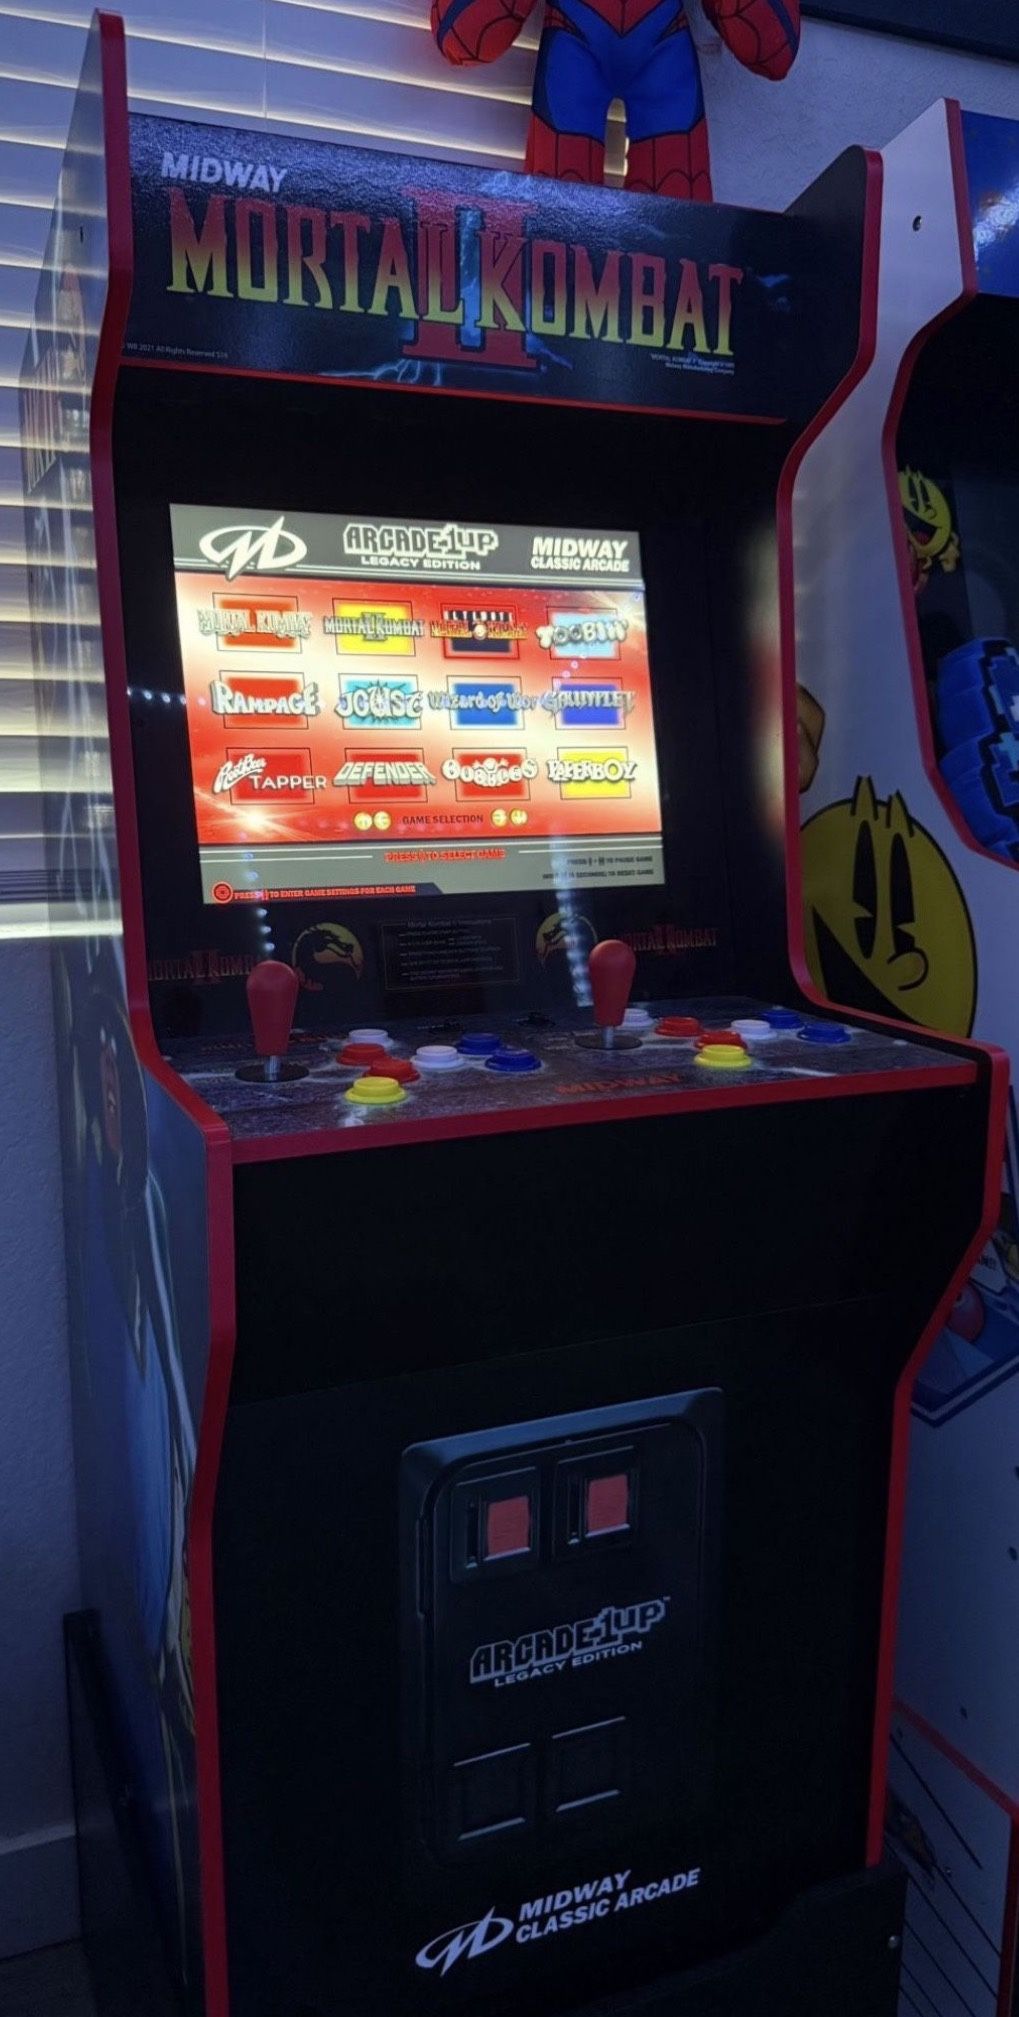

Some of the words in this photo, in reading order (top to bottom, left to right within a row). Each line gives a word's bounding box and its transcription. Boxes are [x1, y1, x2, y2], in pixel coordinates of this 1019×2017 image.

[161, 152, 287, 192] MIDWAY
[166, 187, 464, 325] MORTAL
[476, 229, 743, 356] KOMBAT
[532, 537, 628, 559] MIDWAY
[361, 556, 419, 568] LEGACY
[423, 558, 480, 570] EDITION
[531, 557, 580, 571] CLASSIC
[582, 559, 630, 572] ARCADE
[210, 680, 320, 716] RAMPAGE
[335, 686, 424, 718] JOUST
[427, 691, 486, 710] Wizard
[487, 691, 505, 713] of
[507, 691, 538, 710] Wor
[333, 761, 437, 786] DEFENDER
[546, 758, 637, 783] PAPERBOY
[249, 775, 328, 790] TAPPER
[403, 815, 431, 825] GAME
[433, 814, 484, 824] SELECTION
[385, 851, 418, 863] PRESS
[426, 850, 439, 861] TO
[440, 849, 475, 861] SELECT
[270, 890, 279, 899] TO
[280, 890, 303, 898] ENTER
[305, 889, 325, 897] GAME
[376, 886, 395, 894] EACH
[396, 885, 416, 893] GAME
[555, 1073, 681, 1095] MIDWAY
[494, 1660, 566, 1688] LEGACY
[572, 1641, 643, 1668] EDITION
[515, 1899, 610, 1943] CLASSIC
[613, 1867, 701, 1912] ARCADE
[518, 1869, 631, 1922] MIDWAY
